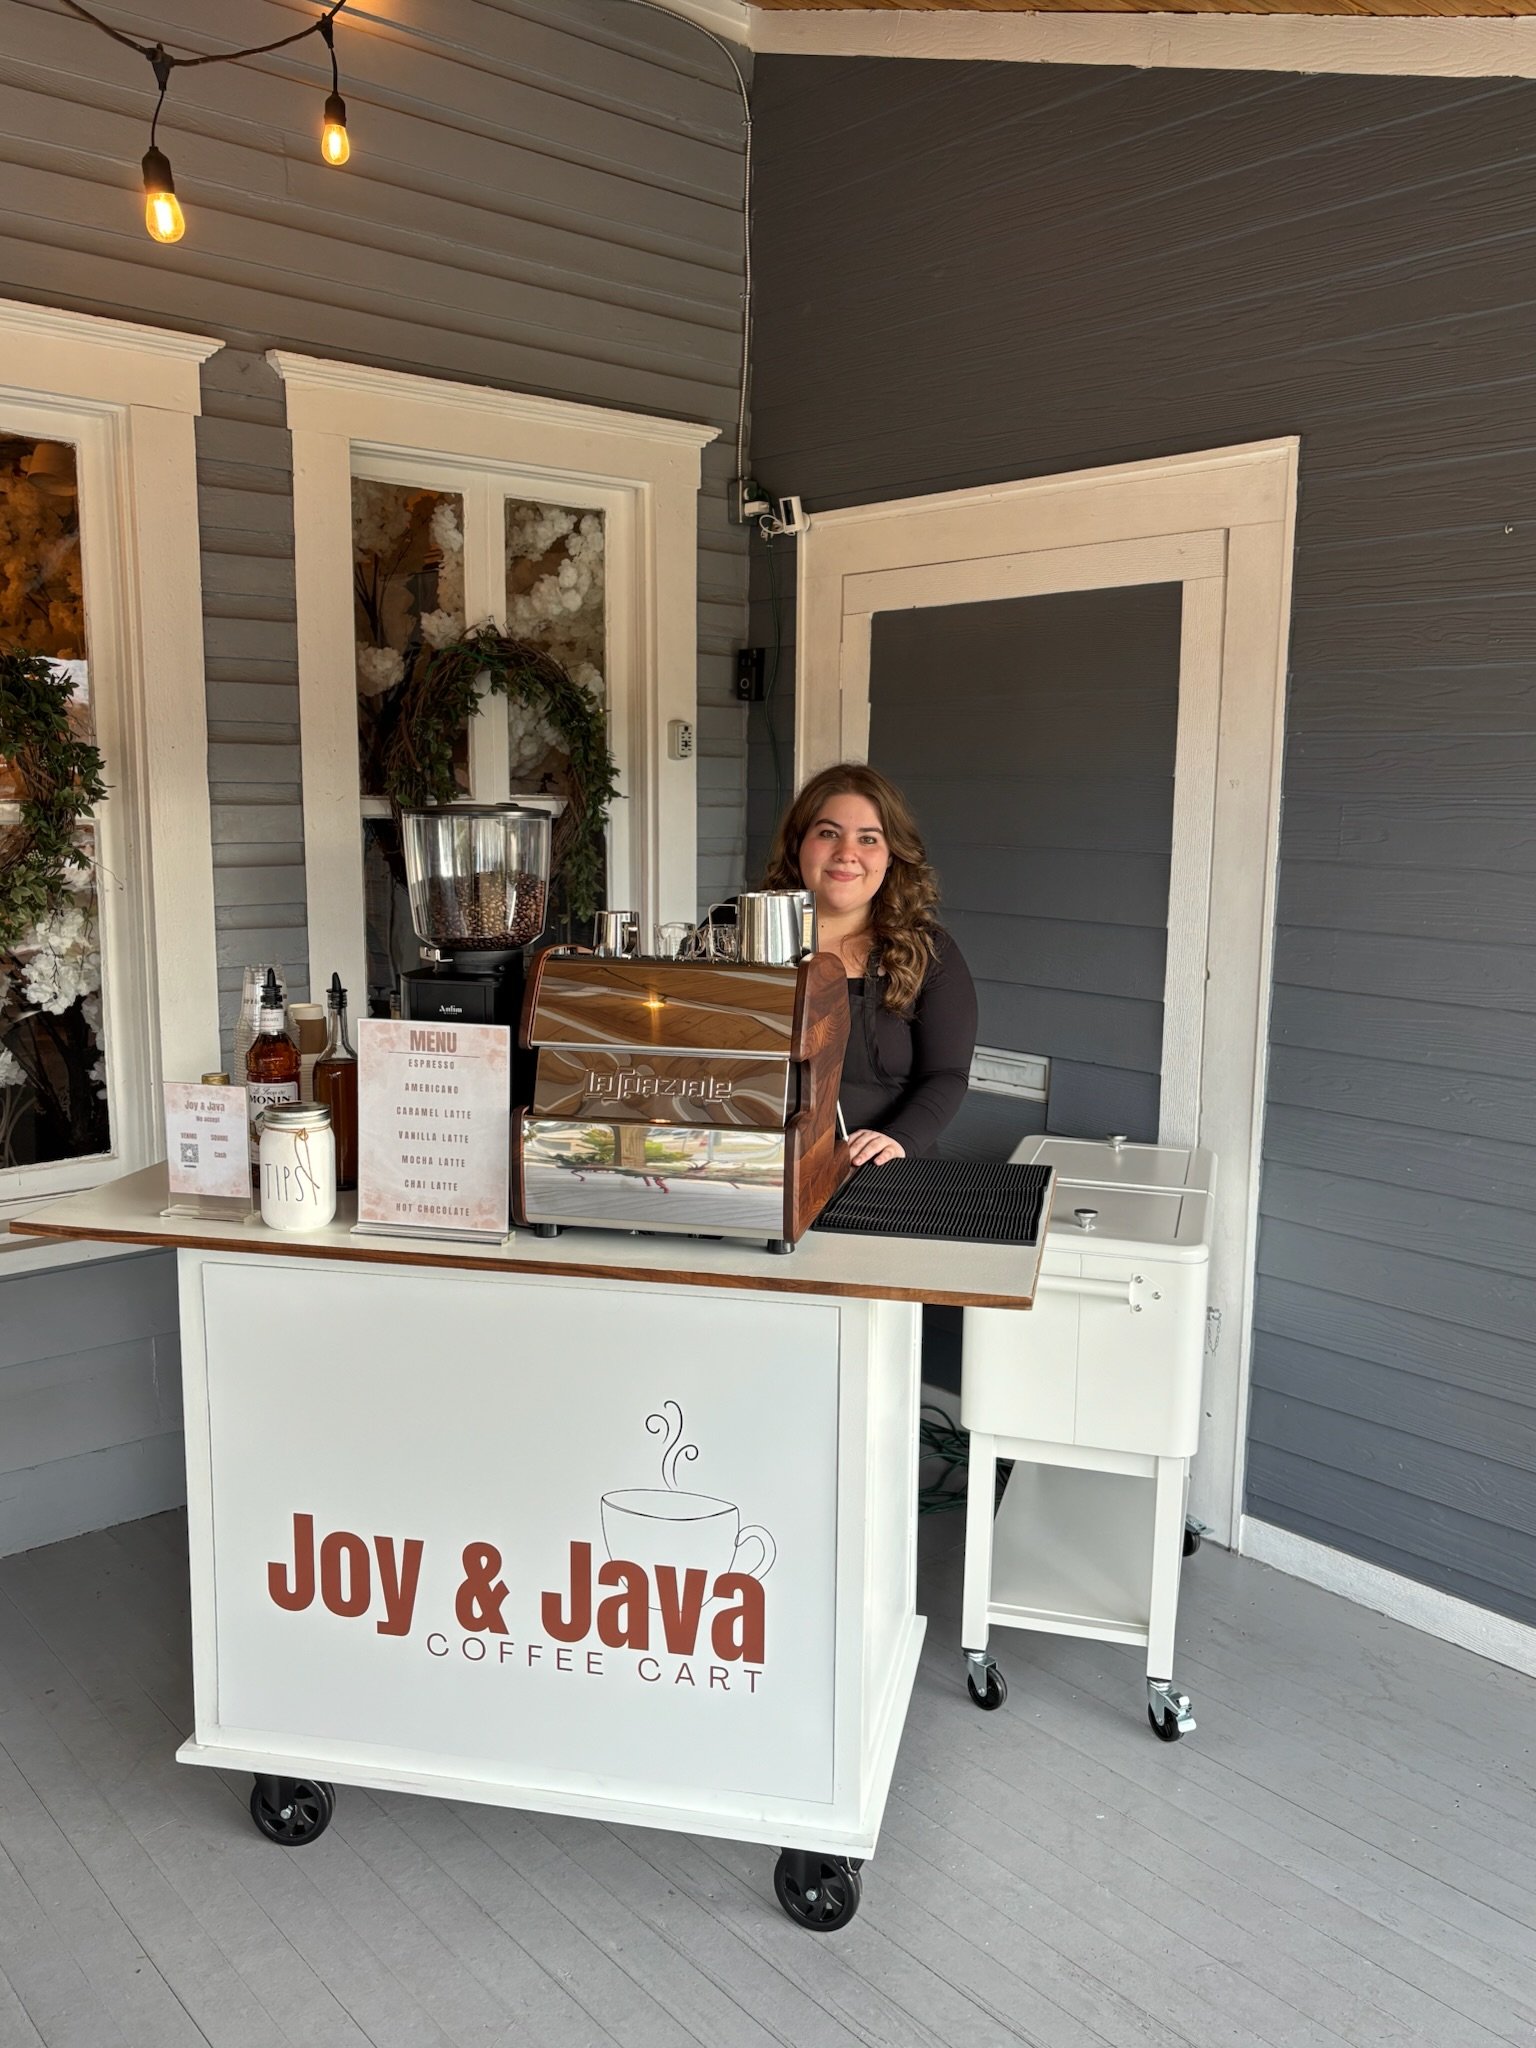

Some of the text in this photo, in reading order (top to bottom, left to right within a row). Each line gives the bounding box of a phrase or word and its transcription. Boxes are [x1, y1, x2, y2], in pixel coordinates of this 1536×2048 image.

[409, 1029, 458, 1054] MENU
[408, 1058, 455, 1070] ESPRESSO
[404, 1082, 459, 1095] AMERICANO
[184, 1100, 198, 1111] Joy
[207, 1101, 225, 1112] Java
[249, 1094, 290, 1104] MONIN
[396, 1106, 472, 1120] CARAMEL LATTE
[398, 1130, 469, 1144] VANILLA LATTE
[401, 1154, 466, 1168] MOCHA LATTE
[265, 1163, 304, 1202] TIPS
[404, 1179, 458, 1192] CHAI LATTE
[396, 1203, 470, 1217] HOT CHOCOLATE
[267, 1512, 766, 1665] Joy & Java
[426, 1632, 764, 1694] COFFEE CART
